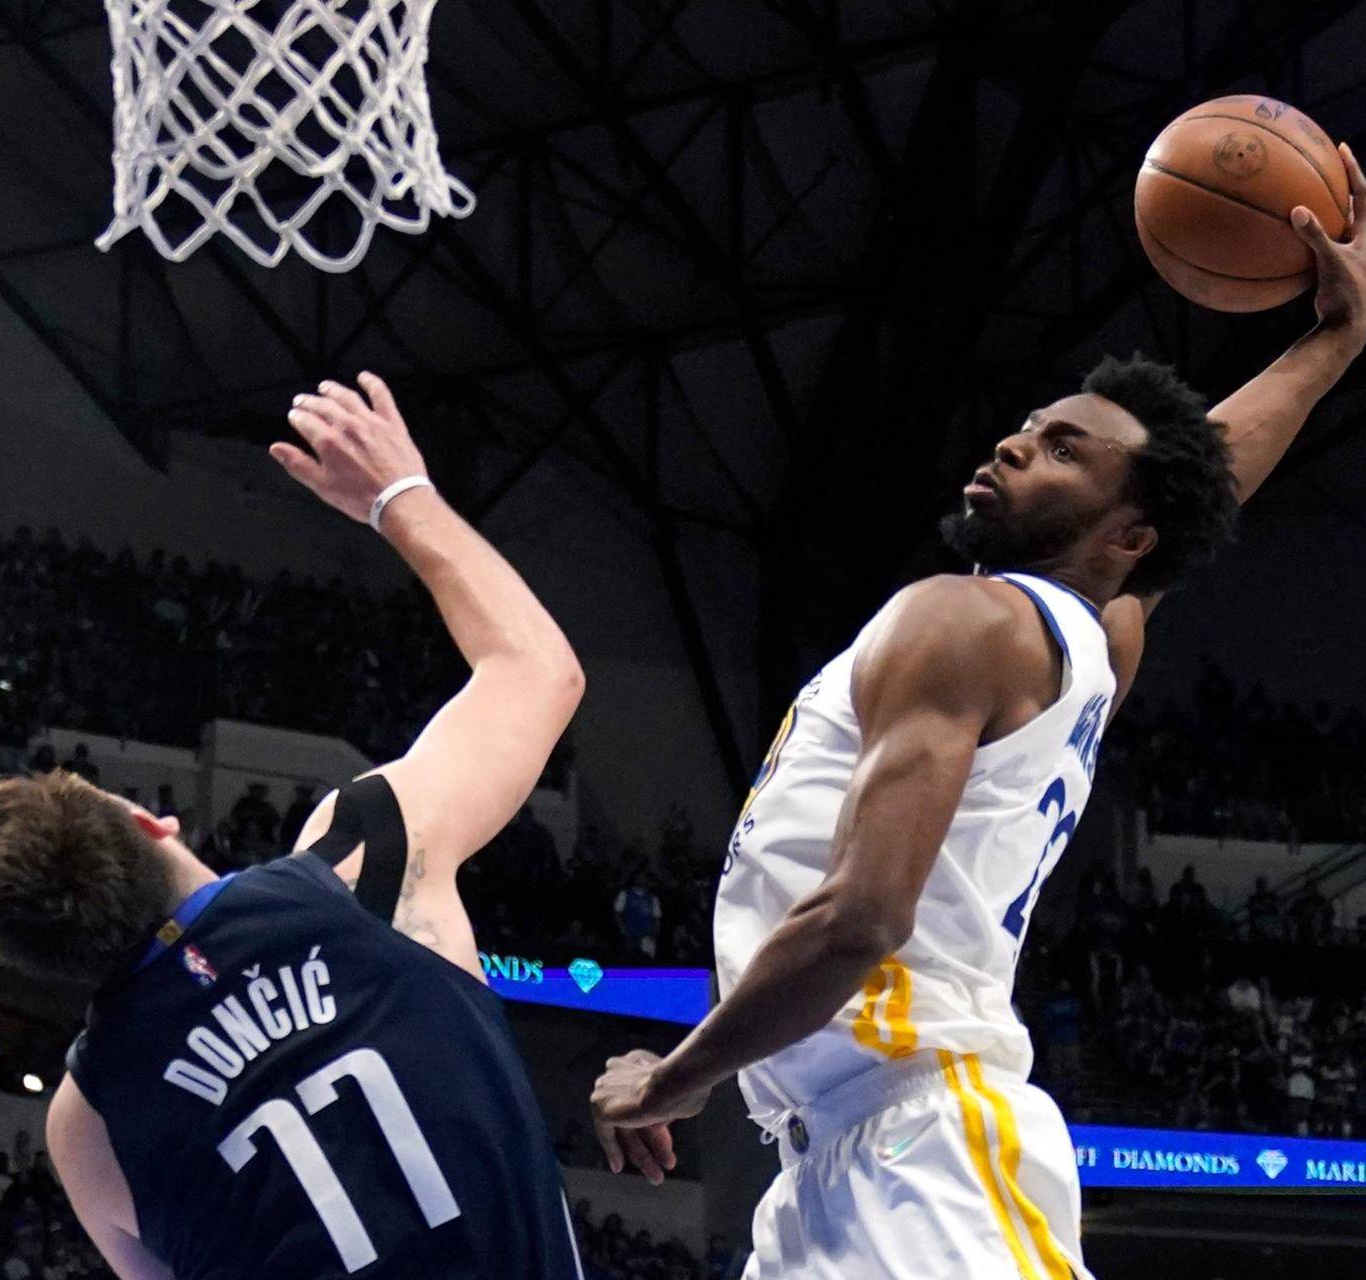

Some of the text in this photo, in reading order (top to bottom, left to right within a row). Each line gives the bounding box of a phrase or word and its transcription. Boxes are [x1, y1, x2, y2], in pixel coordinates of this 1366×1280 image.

[163, 946, 337, 1106] DONČIĆ
[217, 1047, 462, 1275] 77
[1113, 1147, 1241, 1175] DIAMONDS
